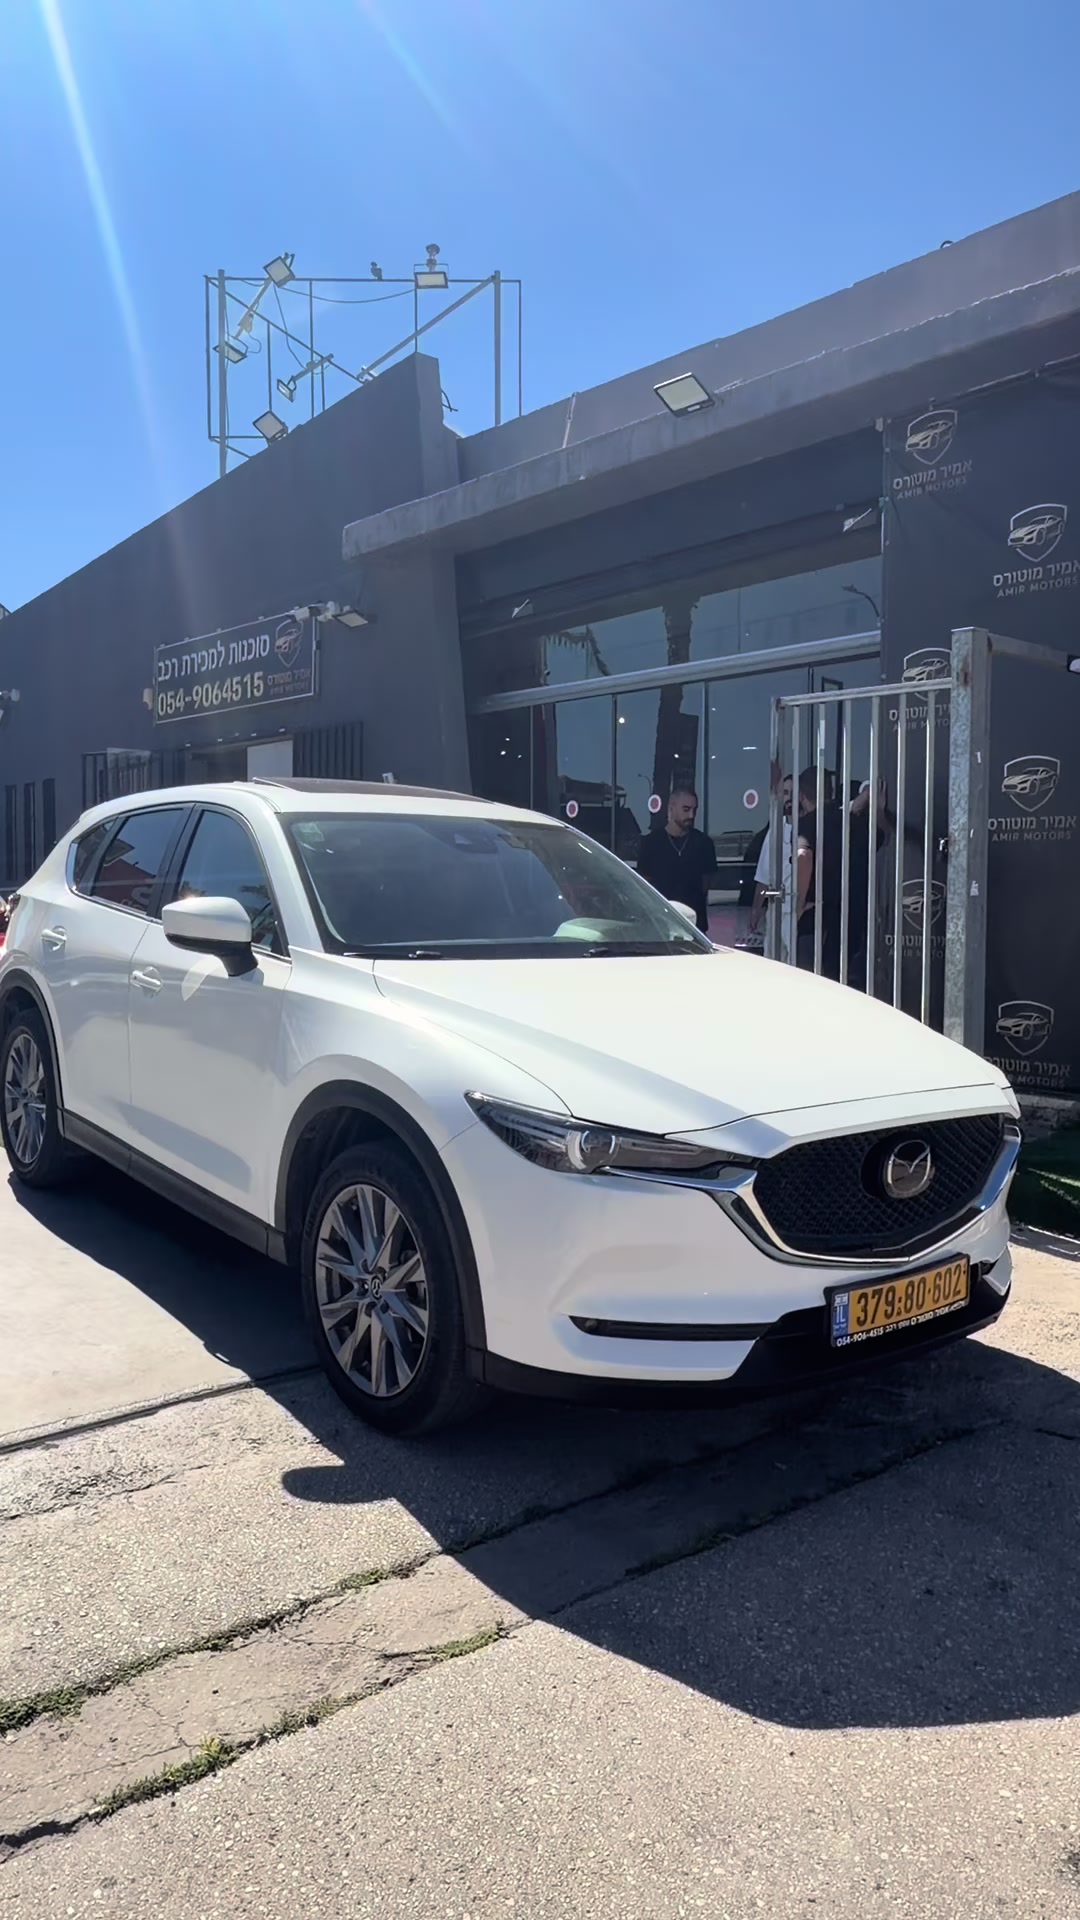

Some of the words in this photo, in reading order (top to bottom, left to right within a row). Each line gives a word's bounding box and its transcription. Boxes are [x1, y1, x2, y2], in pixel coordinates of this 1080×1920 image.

[939, 459, 973, 478] אמיר
[893, 469, 937, 490] מוטורס
[896, 486, 922, 500] AMIR
[925, 475, 967, 492] MOTORS
[993, 566, 1043, 587] מוטורס
[996, 584, 1025, 599] AMIR
[1029, 575, 1078, 593] MOTORS
[180, 640, 225, 676] למכירת
[228, 634, 270, 665] סוכנות
[158, 657, 179, 682] רכב
[158, 671, 264, 716] 054-9064515
[988, 817, 1037, 830] מוטורס
[1040, 816, 1077, 829] אמיר
[992, 832, 1019, 842] AMIR
[1023, 831, 1072, 841] MOTORS
[1034, 1061, 1072, 1078] אמיר
[1017, 1075, 1065, 1089] MOTORS
[836, 1305, 846, 1324] IL
